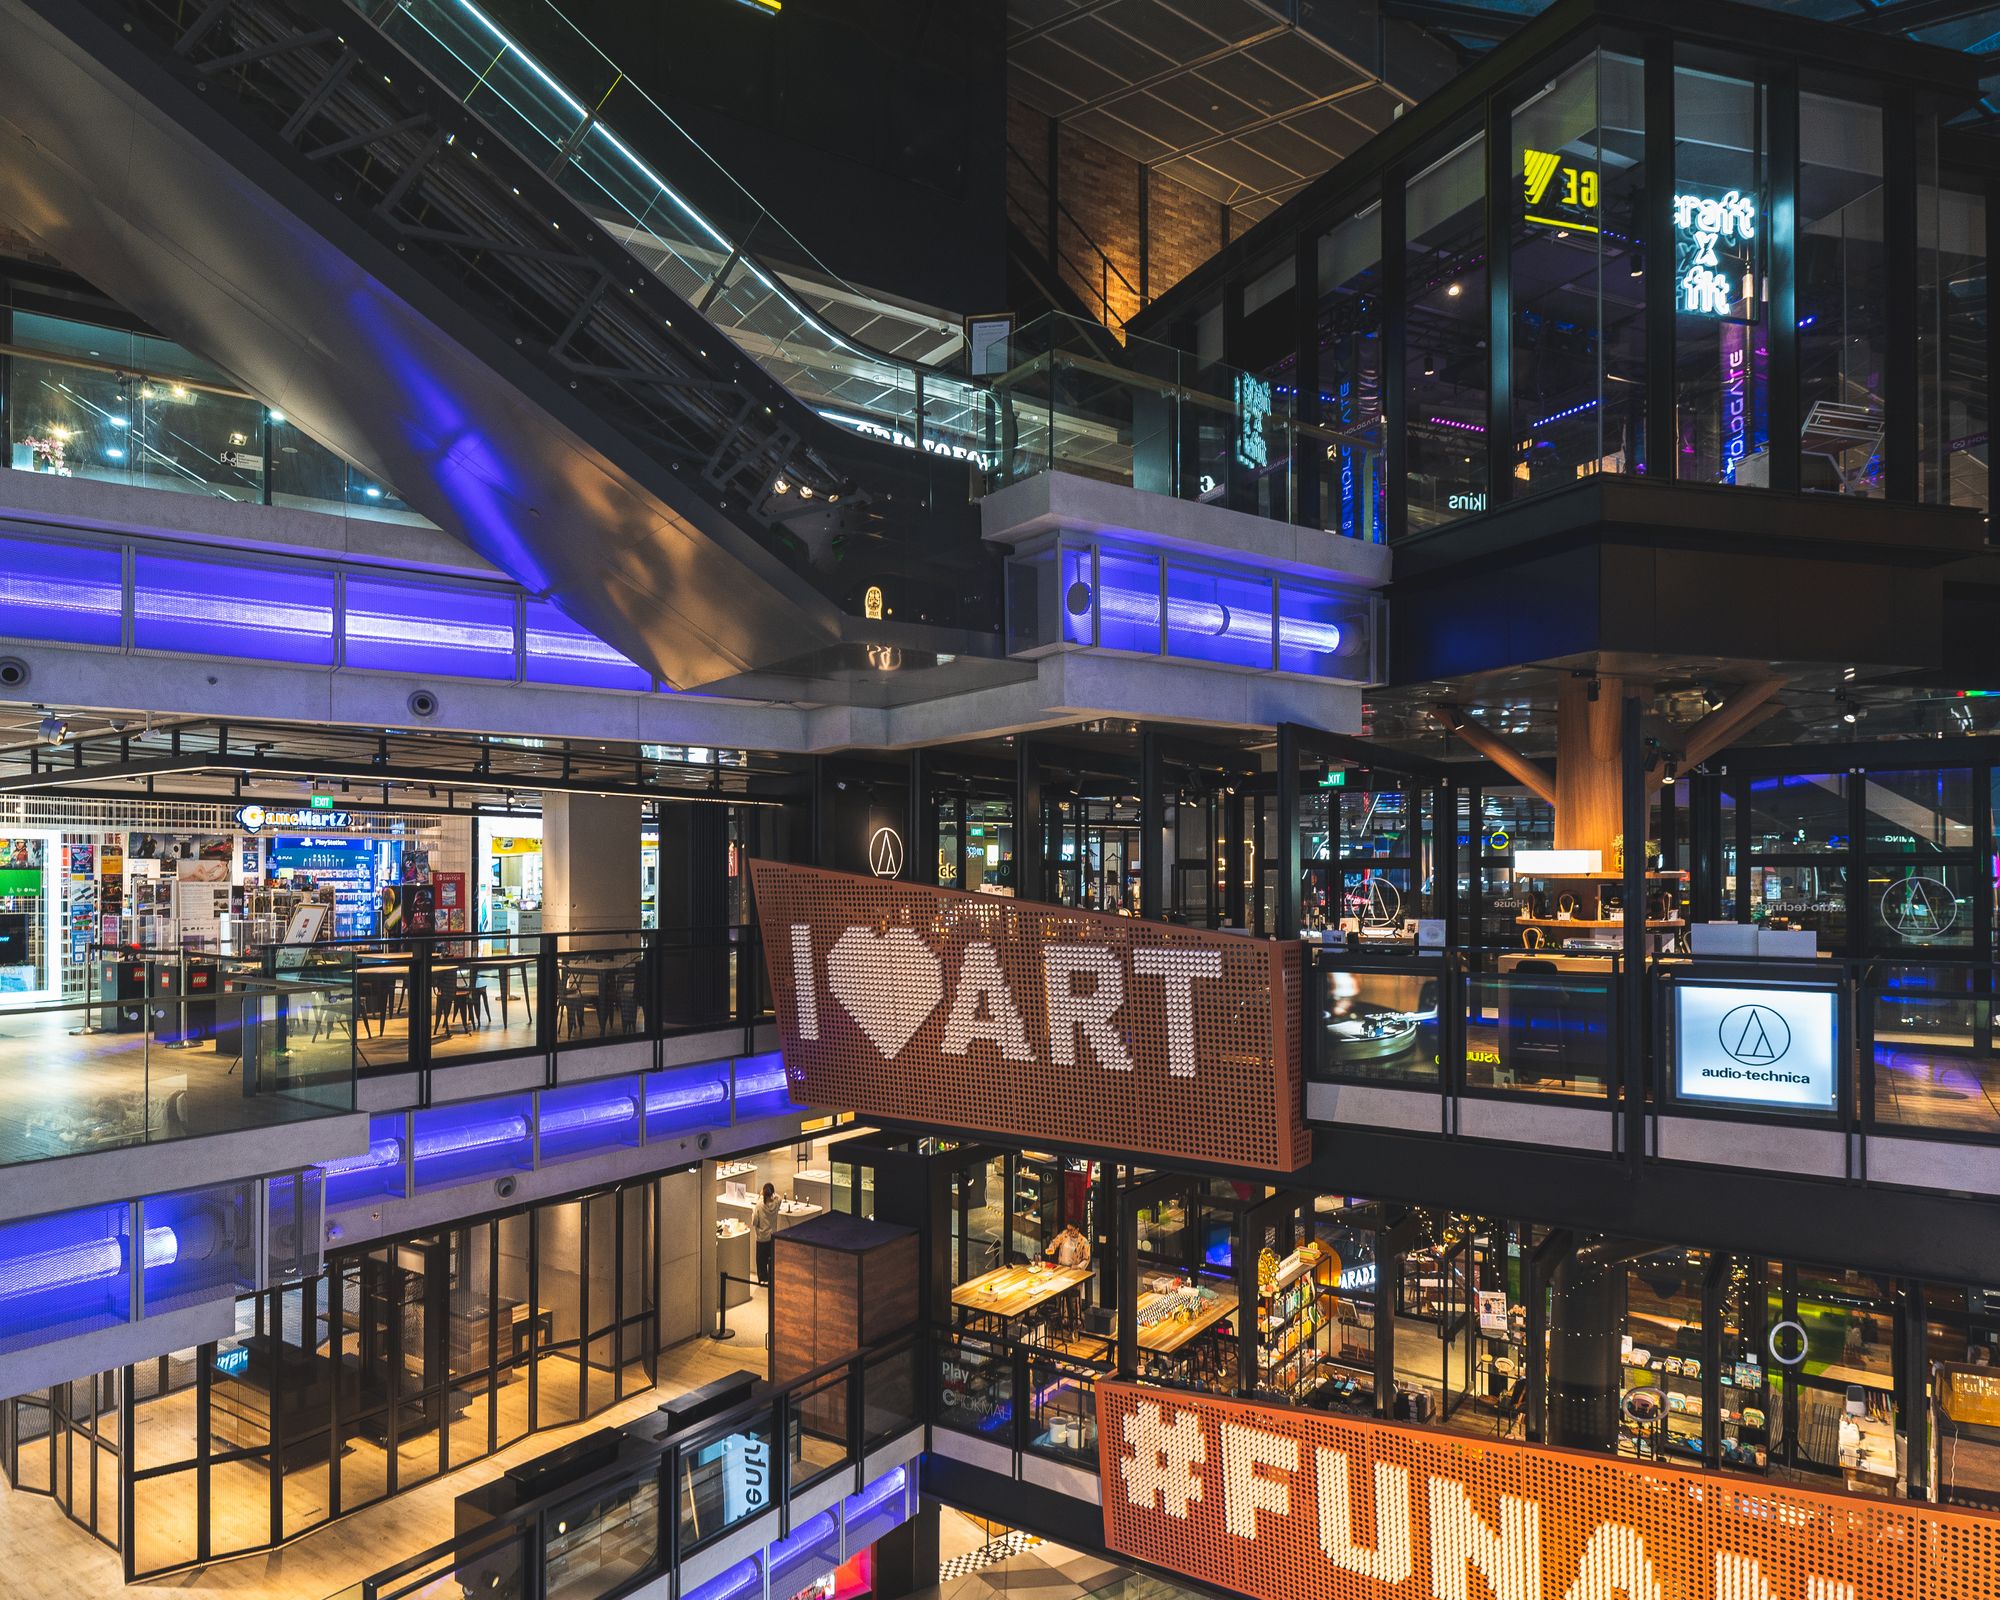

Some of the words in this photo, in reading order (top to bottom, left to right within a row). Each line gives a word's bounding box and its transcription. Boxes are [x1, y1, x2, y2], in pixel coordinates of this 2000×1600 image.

[1328, 773, 1341, 785] XIT
[314, 797, 330, 807] EXIT
[790, 924, 820, 1042] I
[940, 942, 1223, 1078] ART
[1702, 1067, 1811, 1085] audio-technica
[942, 1361, 969, 1384] Play
